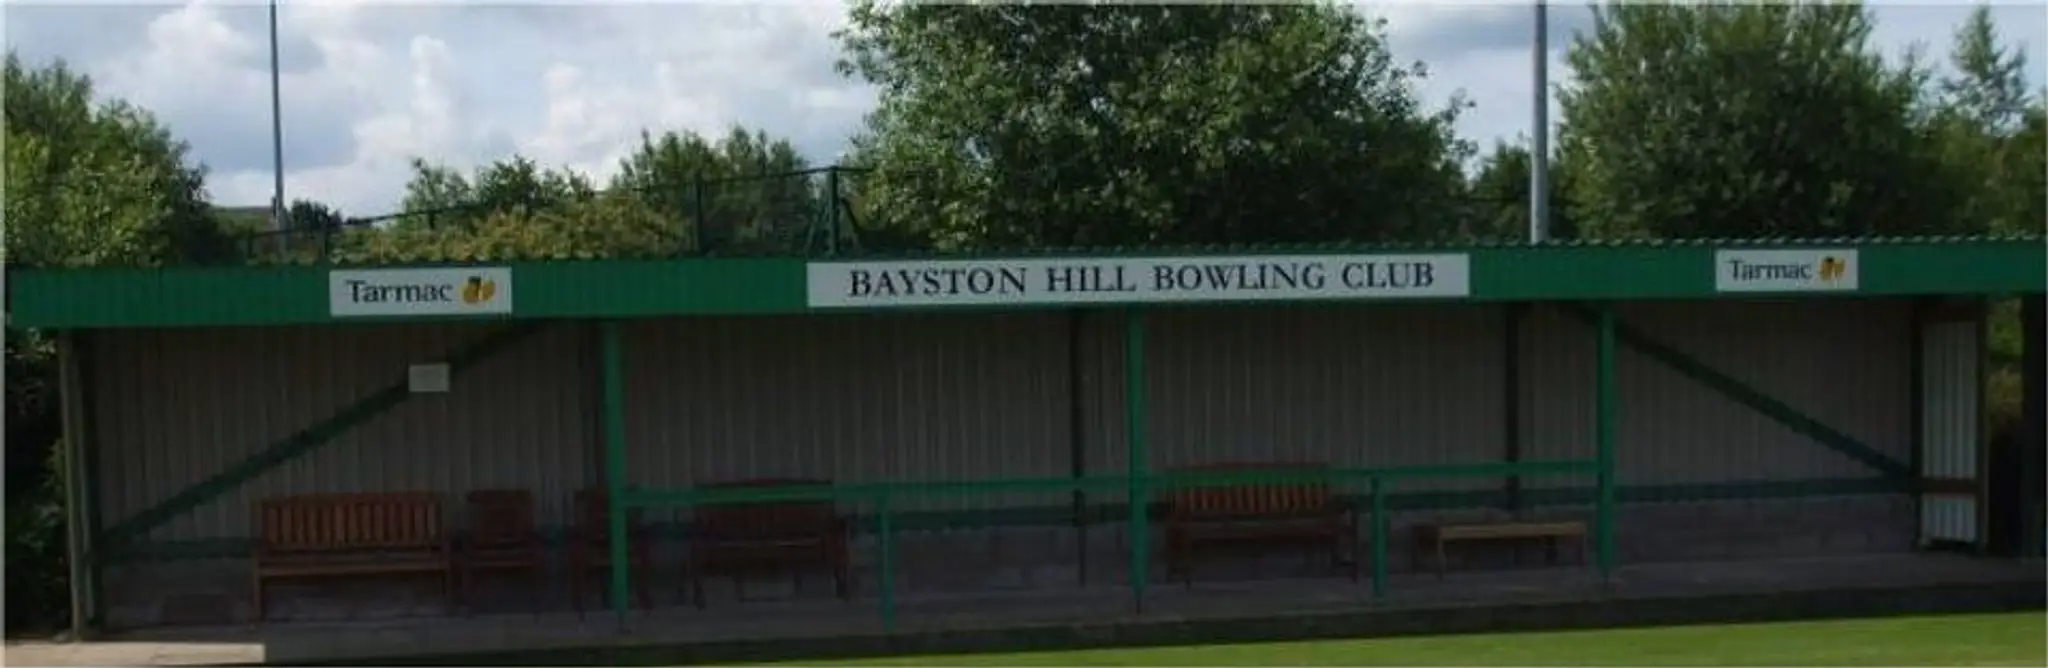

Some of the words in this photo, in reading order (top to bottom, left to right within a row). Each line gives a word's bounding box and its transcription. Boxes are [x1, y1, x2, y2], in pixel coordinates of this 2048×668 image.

[849, 267, 1027, 297] BAYSTON
[1045, 264, 1136, 293] HILL
[1152, 261, 1325, 291] BOWLING
[1341, 260, 1435, 288] CLUB
[1725, 259, 1813, 282] Tarmac
[346, 279, 453, 304] Tarmac
